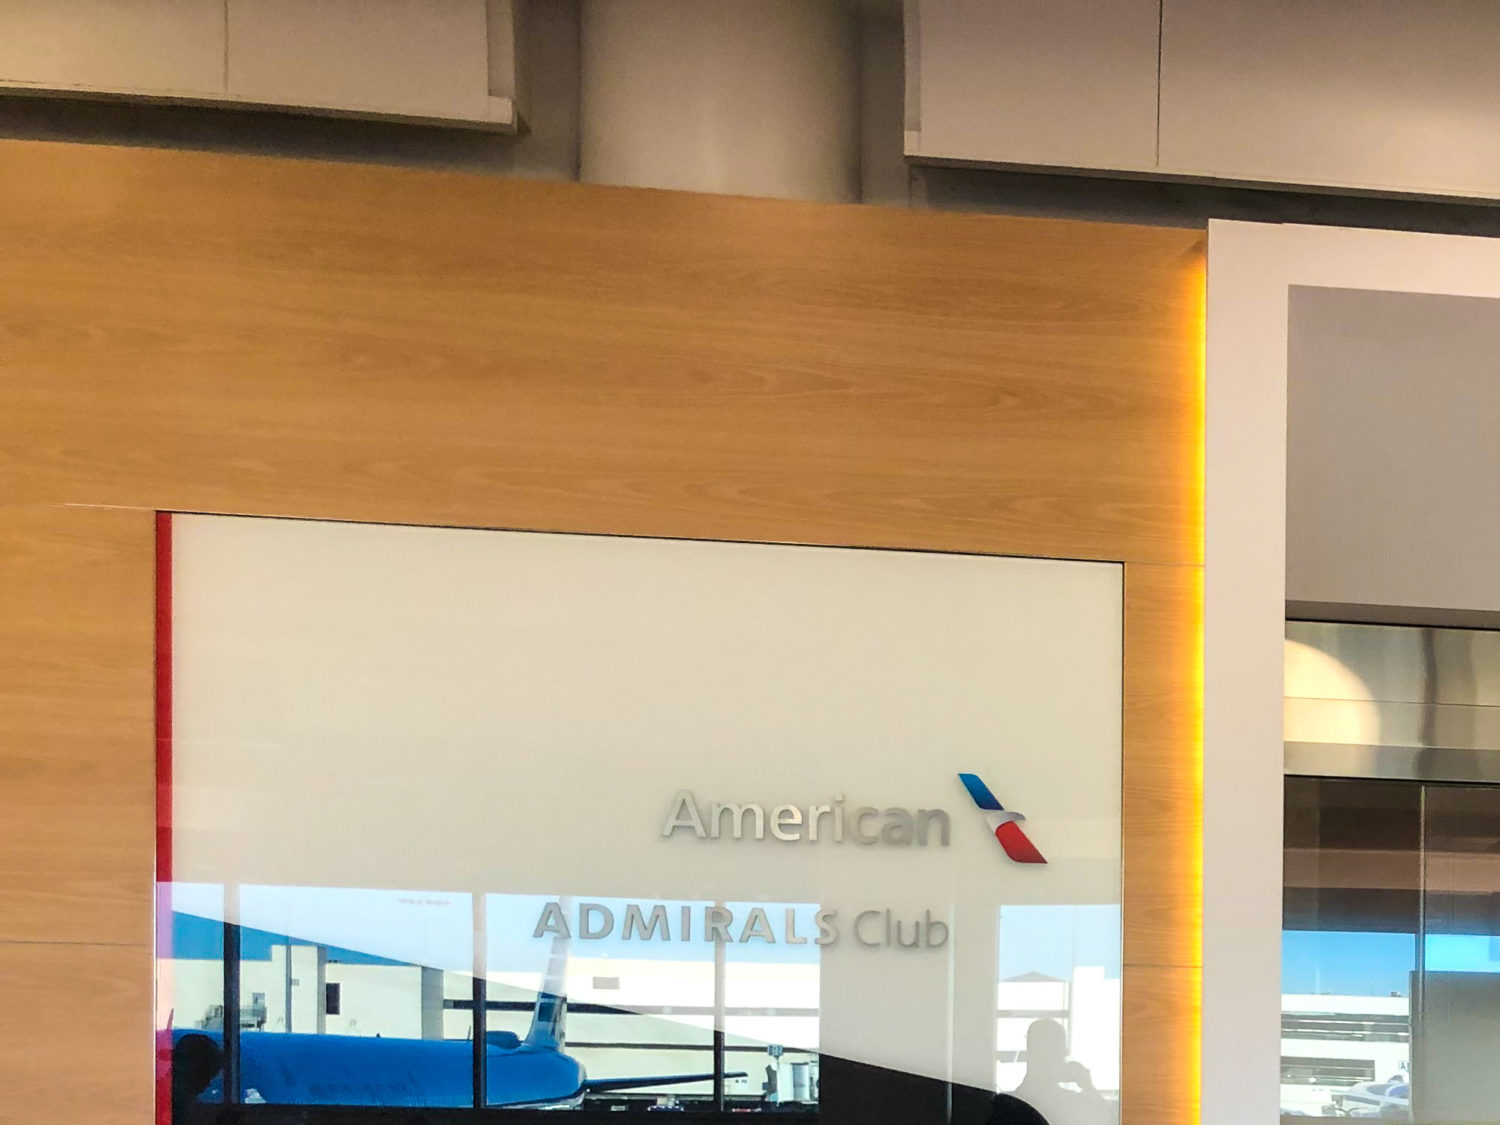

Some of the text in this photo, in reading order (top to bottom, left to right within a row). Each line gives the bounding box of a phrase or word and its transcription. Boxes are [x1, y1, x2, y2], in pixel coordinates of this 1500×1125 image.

[660, 789, 951, 847] American
[533, 901, 951, 950] ADMIRALS Club
